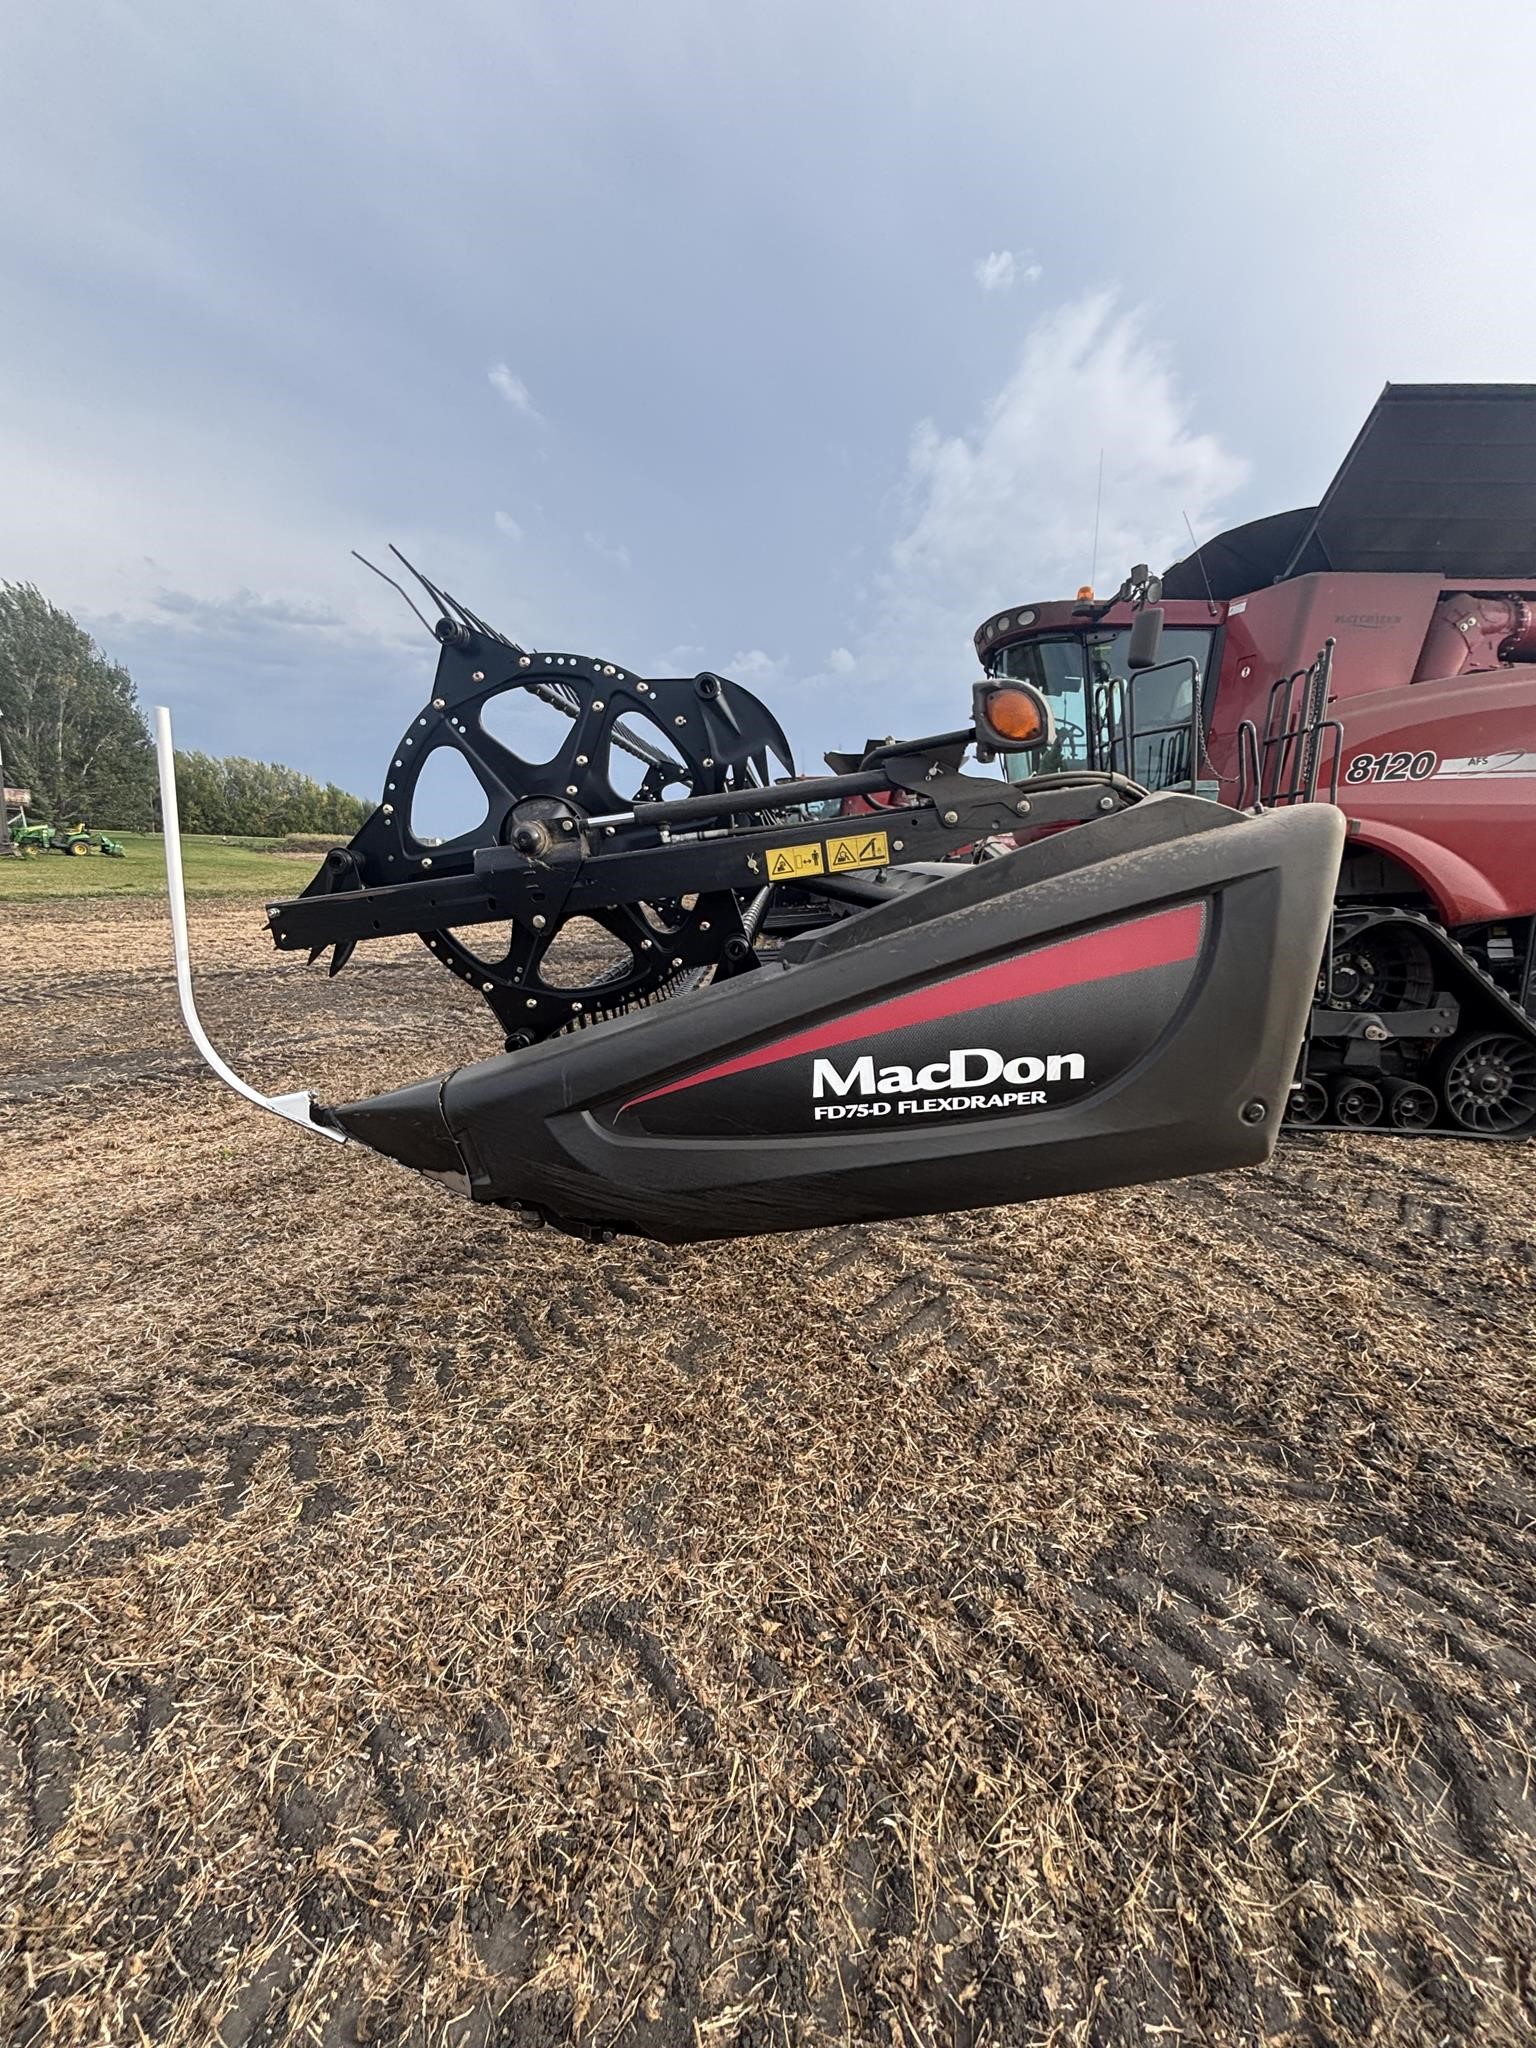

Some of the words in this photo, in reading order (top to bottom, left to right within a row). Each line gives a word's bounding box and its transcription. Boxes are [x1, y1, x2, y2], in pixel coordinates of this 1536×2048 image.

[1345, 750, 1436, 784] 8120
[1467, 757, 1488, 766] AFS
[812, 1048, 1085, 1098] MacDon
[814, 1102, 892, 1120] FD75-D
[898, 1090, 1047, 1115] FLEXDRAPER
